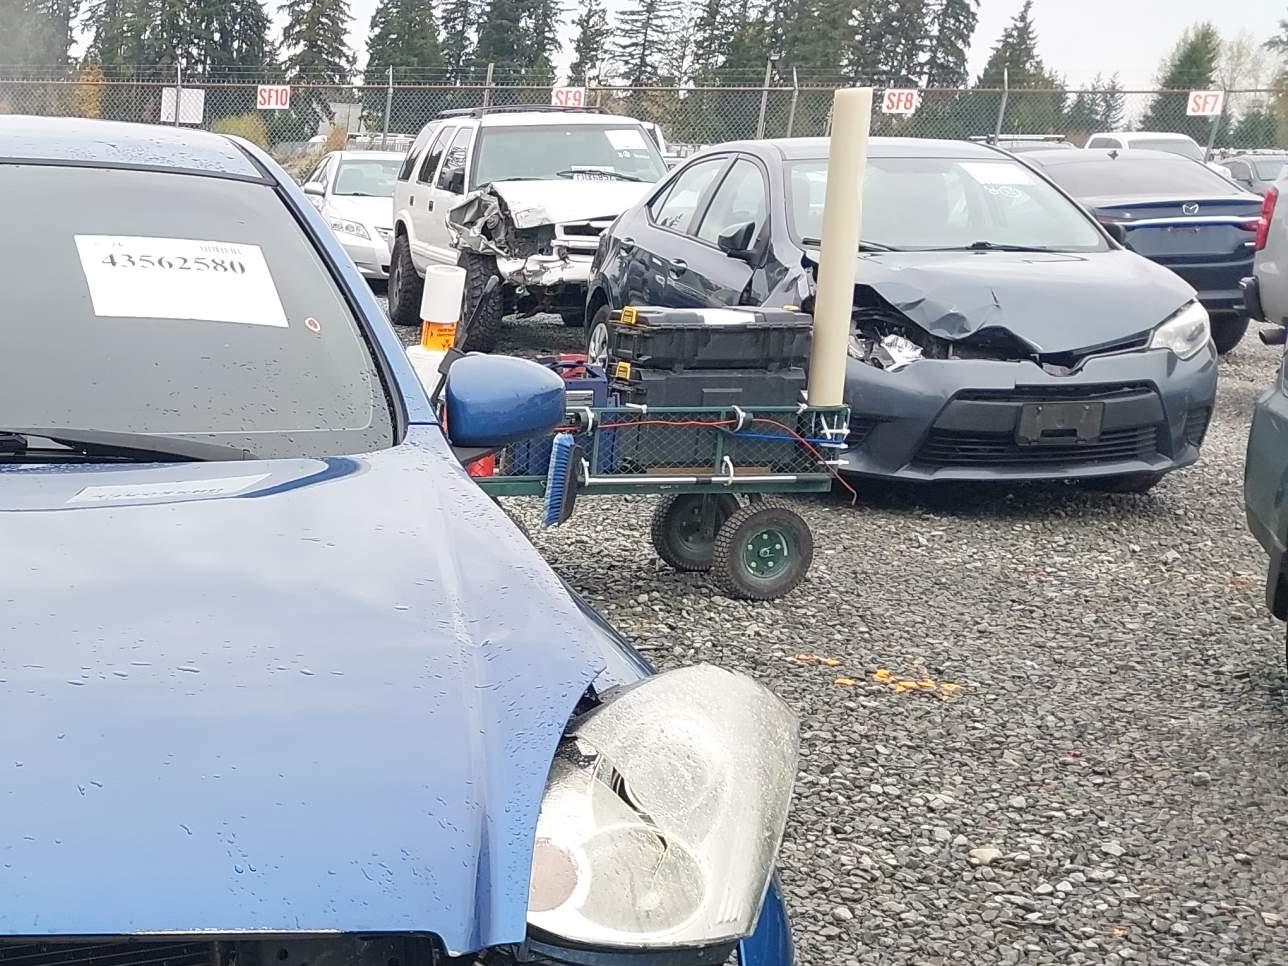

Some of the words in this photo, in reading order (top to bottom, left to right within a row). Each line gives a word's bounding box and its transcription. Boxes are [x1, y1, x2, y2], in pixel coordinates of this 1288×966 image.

[259, 88, 288, 106] SF10
[555, 90, 582, 106] SF9
[886, 92, 914, 110] SF8
[1191, 94, 1220, 113] SF7
[101, 253, 246, 275] 43562580
